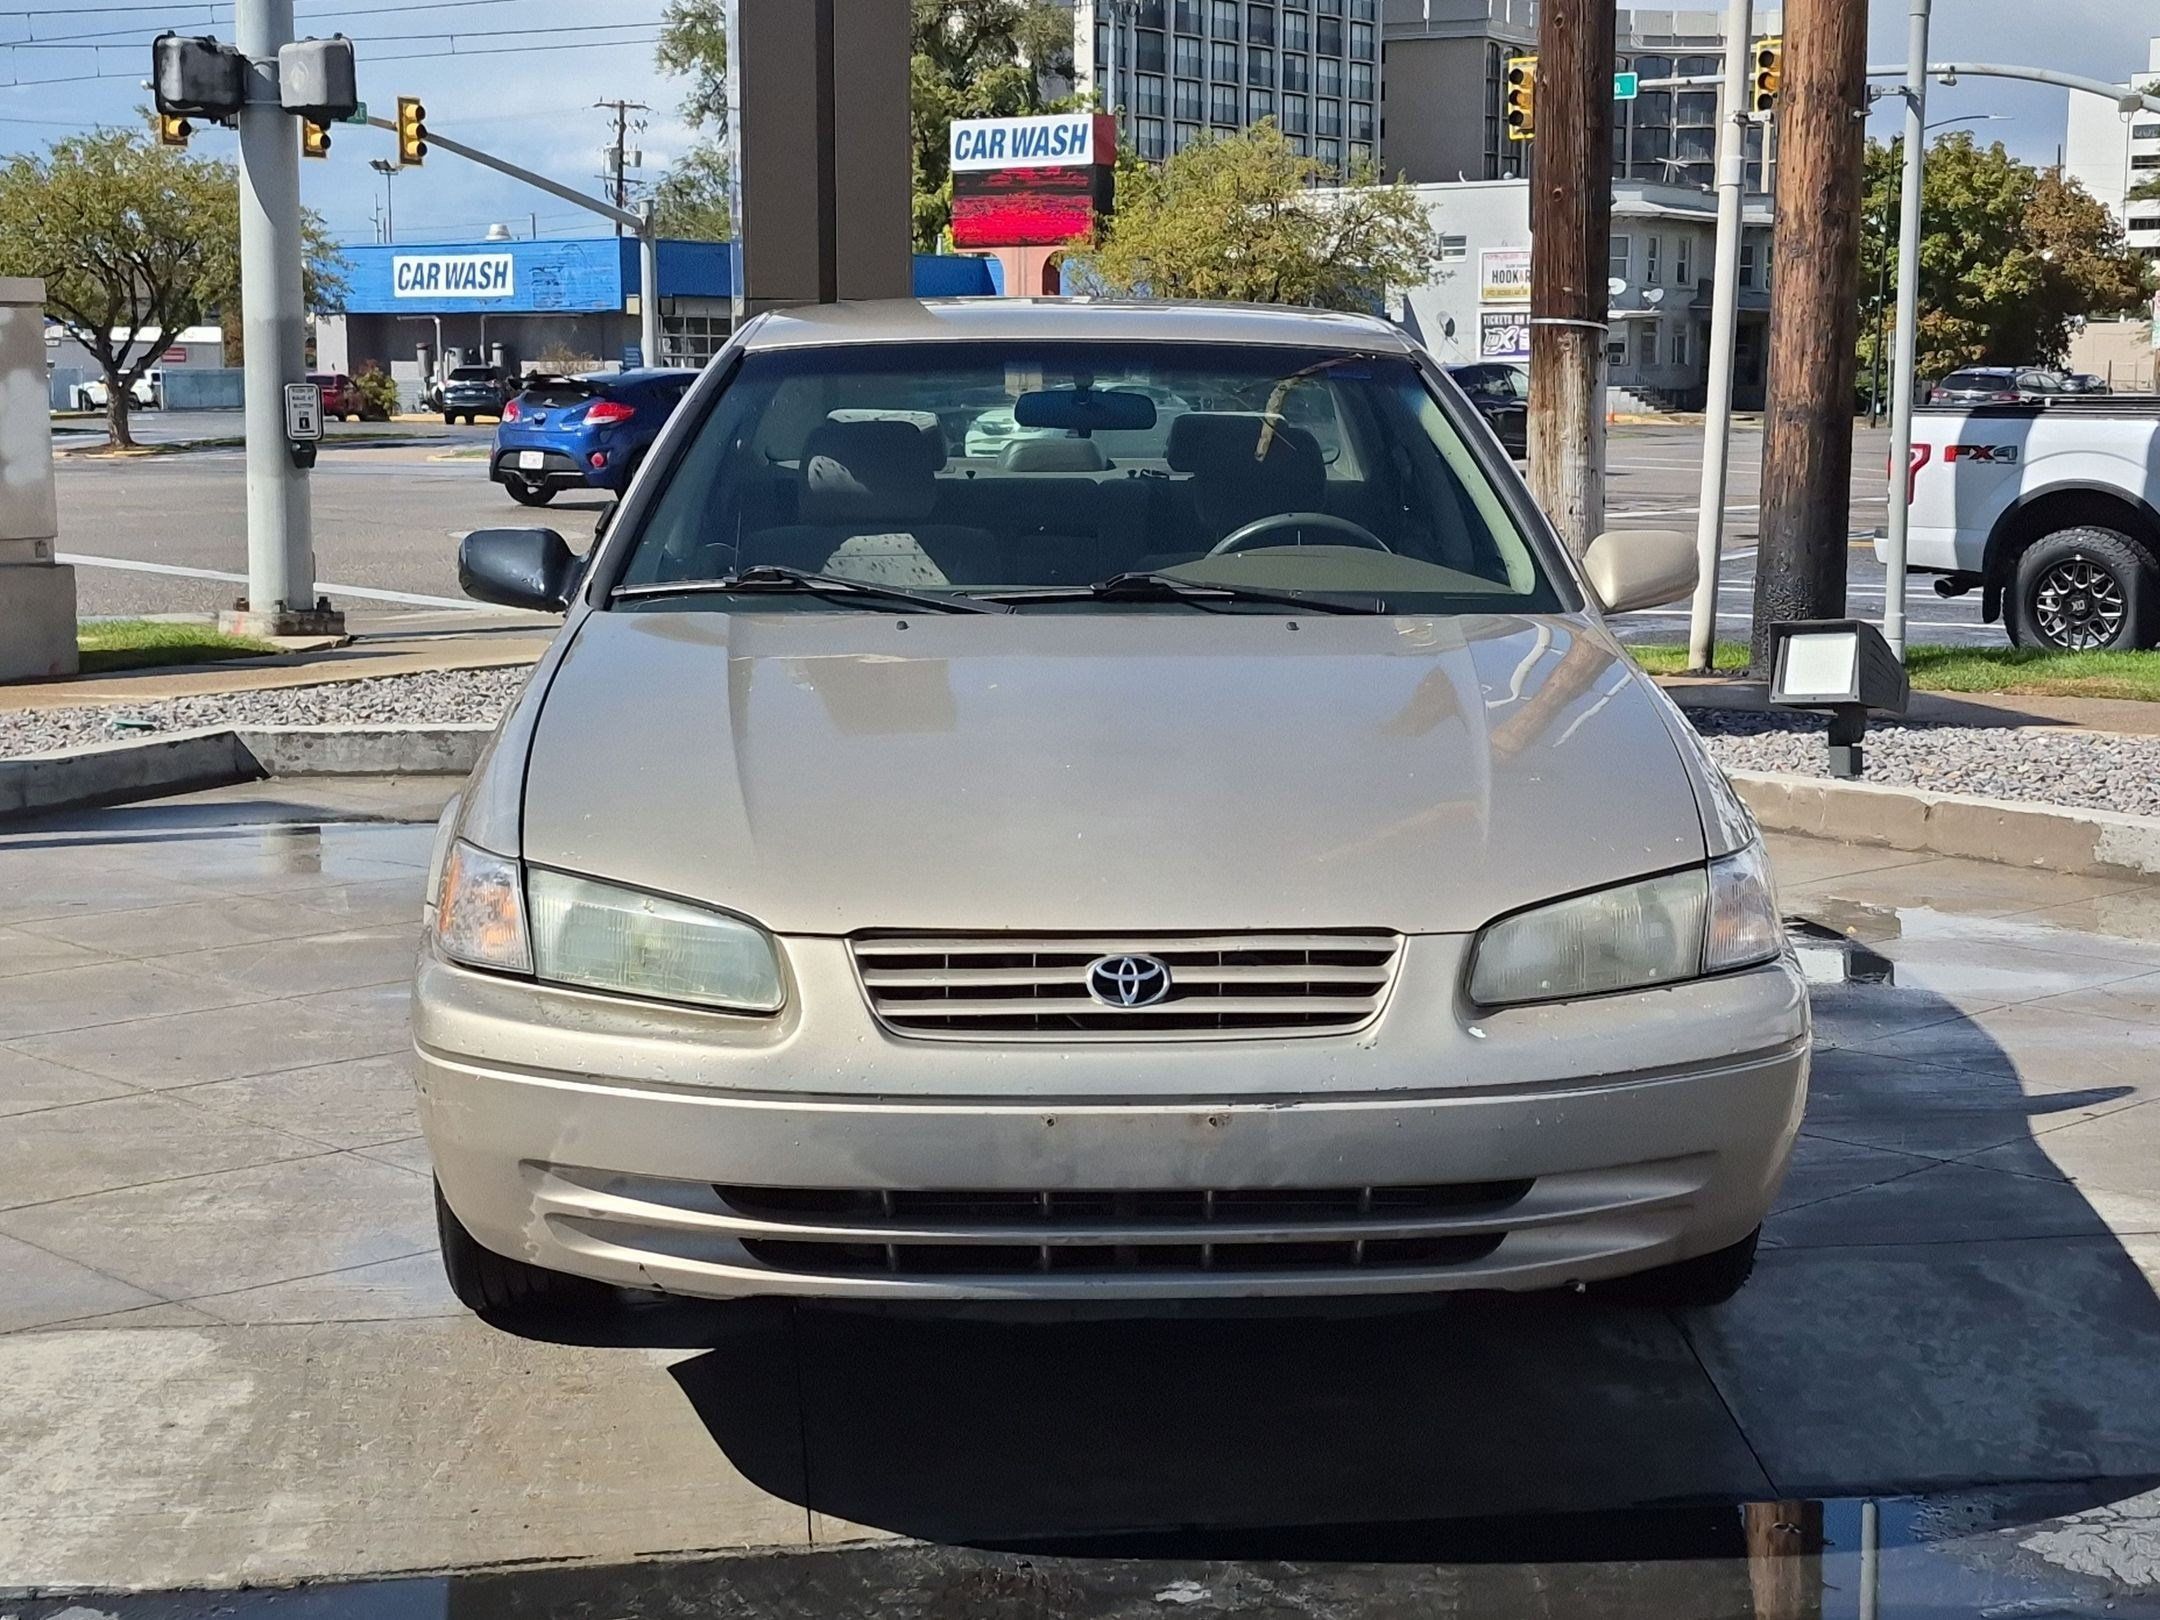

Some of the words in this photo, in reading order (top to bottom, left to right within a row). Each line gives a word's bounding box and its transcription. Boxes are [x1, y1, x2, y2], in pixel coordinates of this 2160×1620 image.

[954, 128, 1007, 161] CAR
[1011, 123, 1089, 158] WASH
[397, 262, 441, 291] CAR
[444, 260, 509, 290] WASH
[1483, 315, 1513, 326] TICKETS
[1944, 445, 2018, 463] FX4
